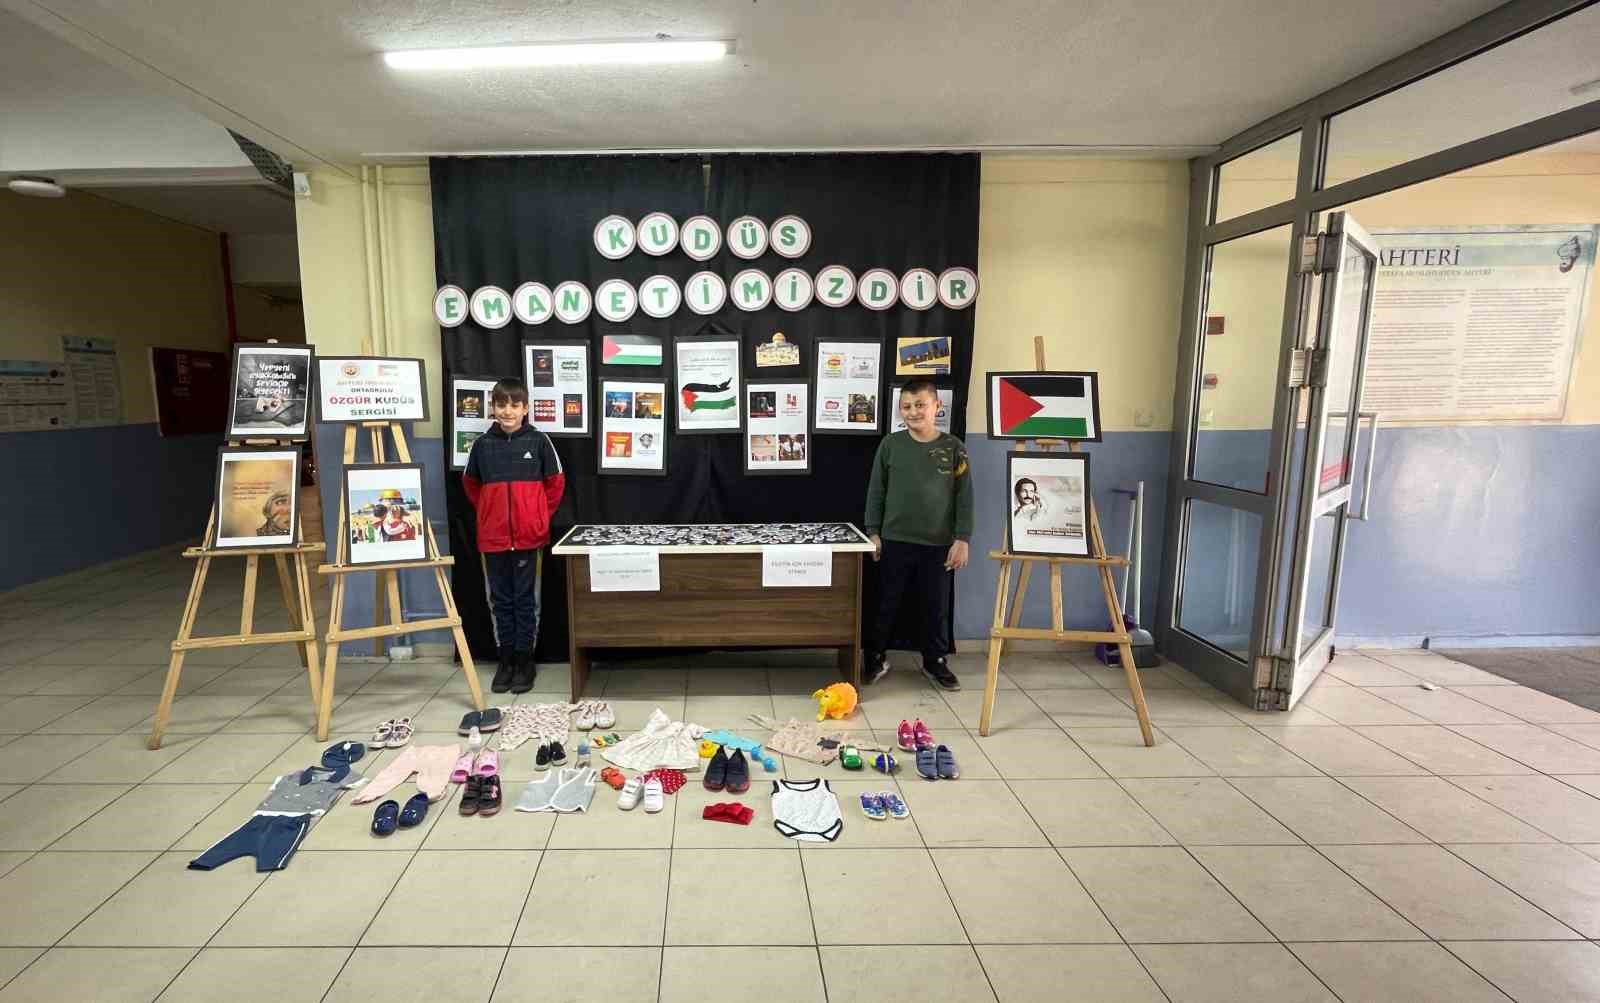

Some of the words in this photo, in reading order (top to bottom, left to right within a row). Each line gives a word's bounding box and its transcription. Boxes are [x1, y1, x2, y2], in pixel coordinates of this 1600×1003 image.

[608, 223, 796, 250] KUDÜS
[444, 275, 967, 319] EMANETİMİZDİR
[329, 394, 372, 405] ÖZGÜR
[375, 394, 415, 405] KUDÜS
[350, 407, 397, 416] SERGİSİ
